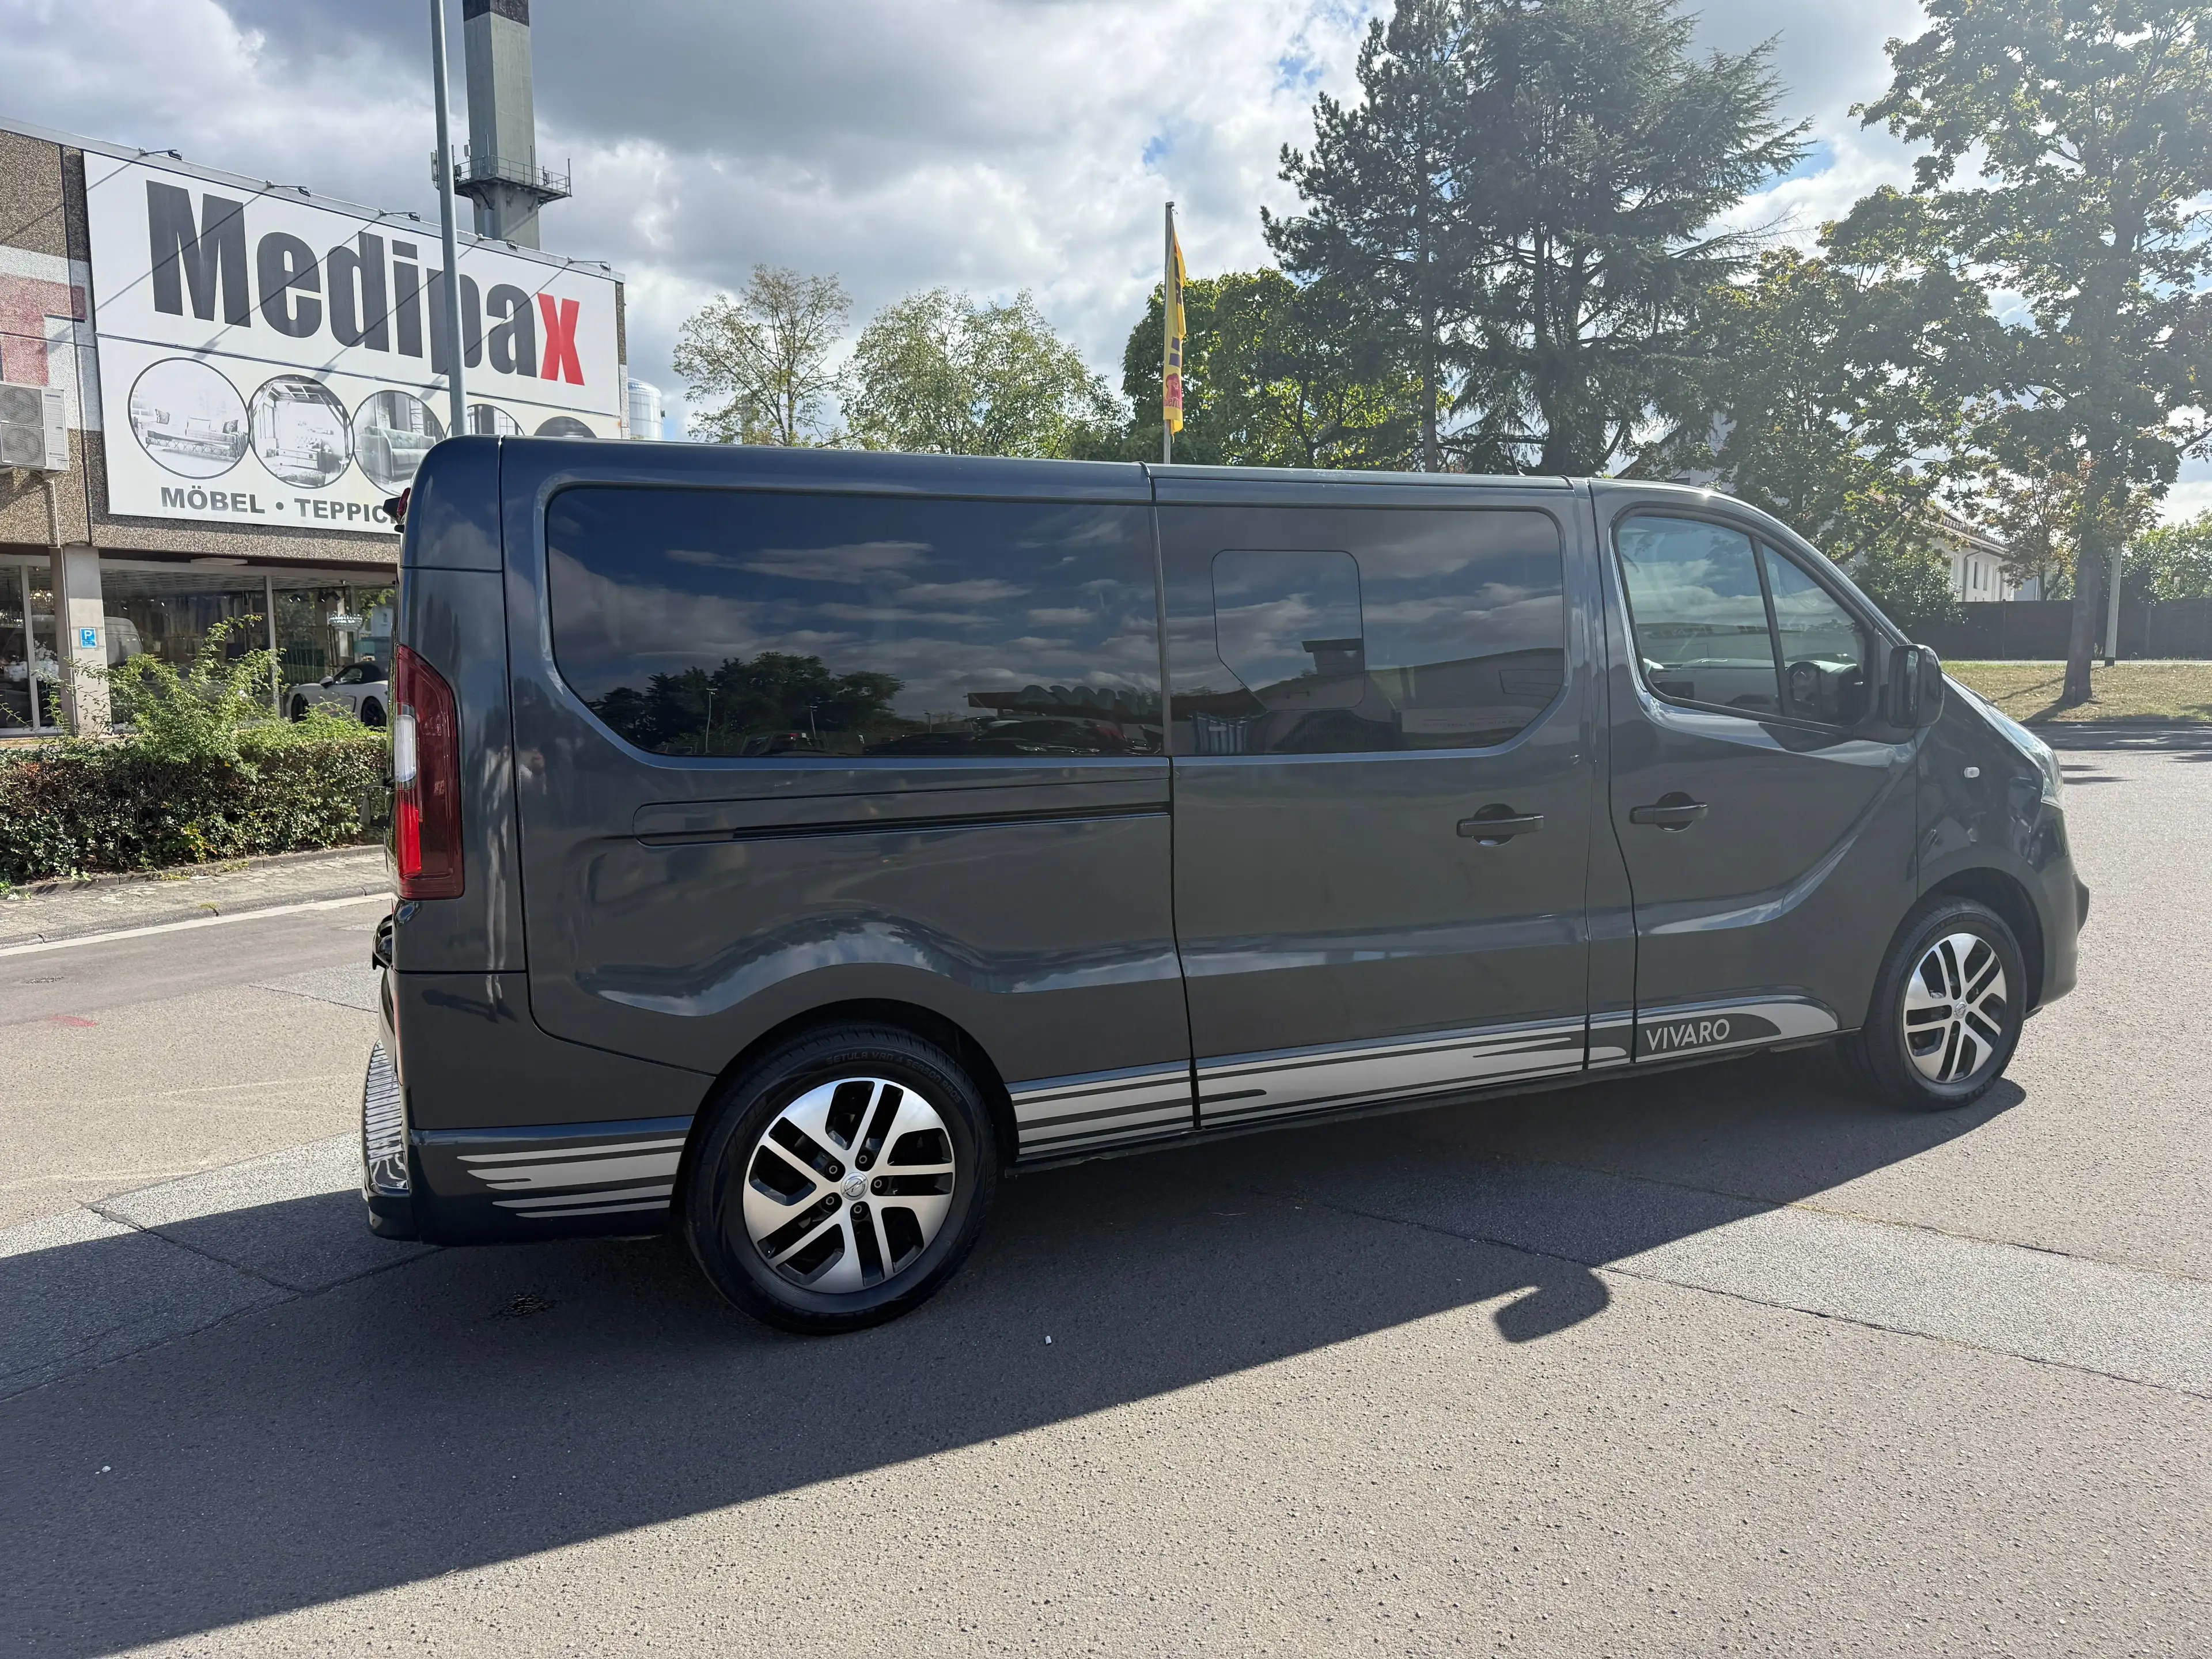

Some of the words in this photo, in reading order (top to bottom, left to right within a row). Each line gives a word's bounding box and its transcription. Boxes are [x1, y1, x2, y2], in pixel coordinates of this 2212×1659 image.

[146, 179, 585, 386] Medipax
[161, 485, 266, 514] MÖBEL
[294, 498, 396, 524] TEPPIC
[84, 630, 92, 639] P
[1646, 1018, 1730, 1051] VIVARO
[825, 1051, 868, 1065] SETULA
[871, 1051, 894, 1061] VAN
[906, 1058, 941, 1084] SEASON
